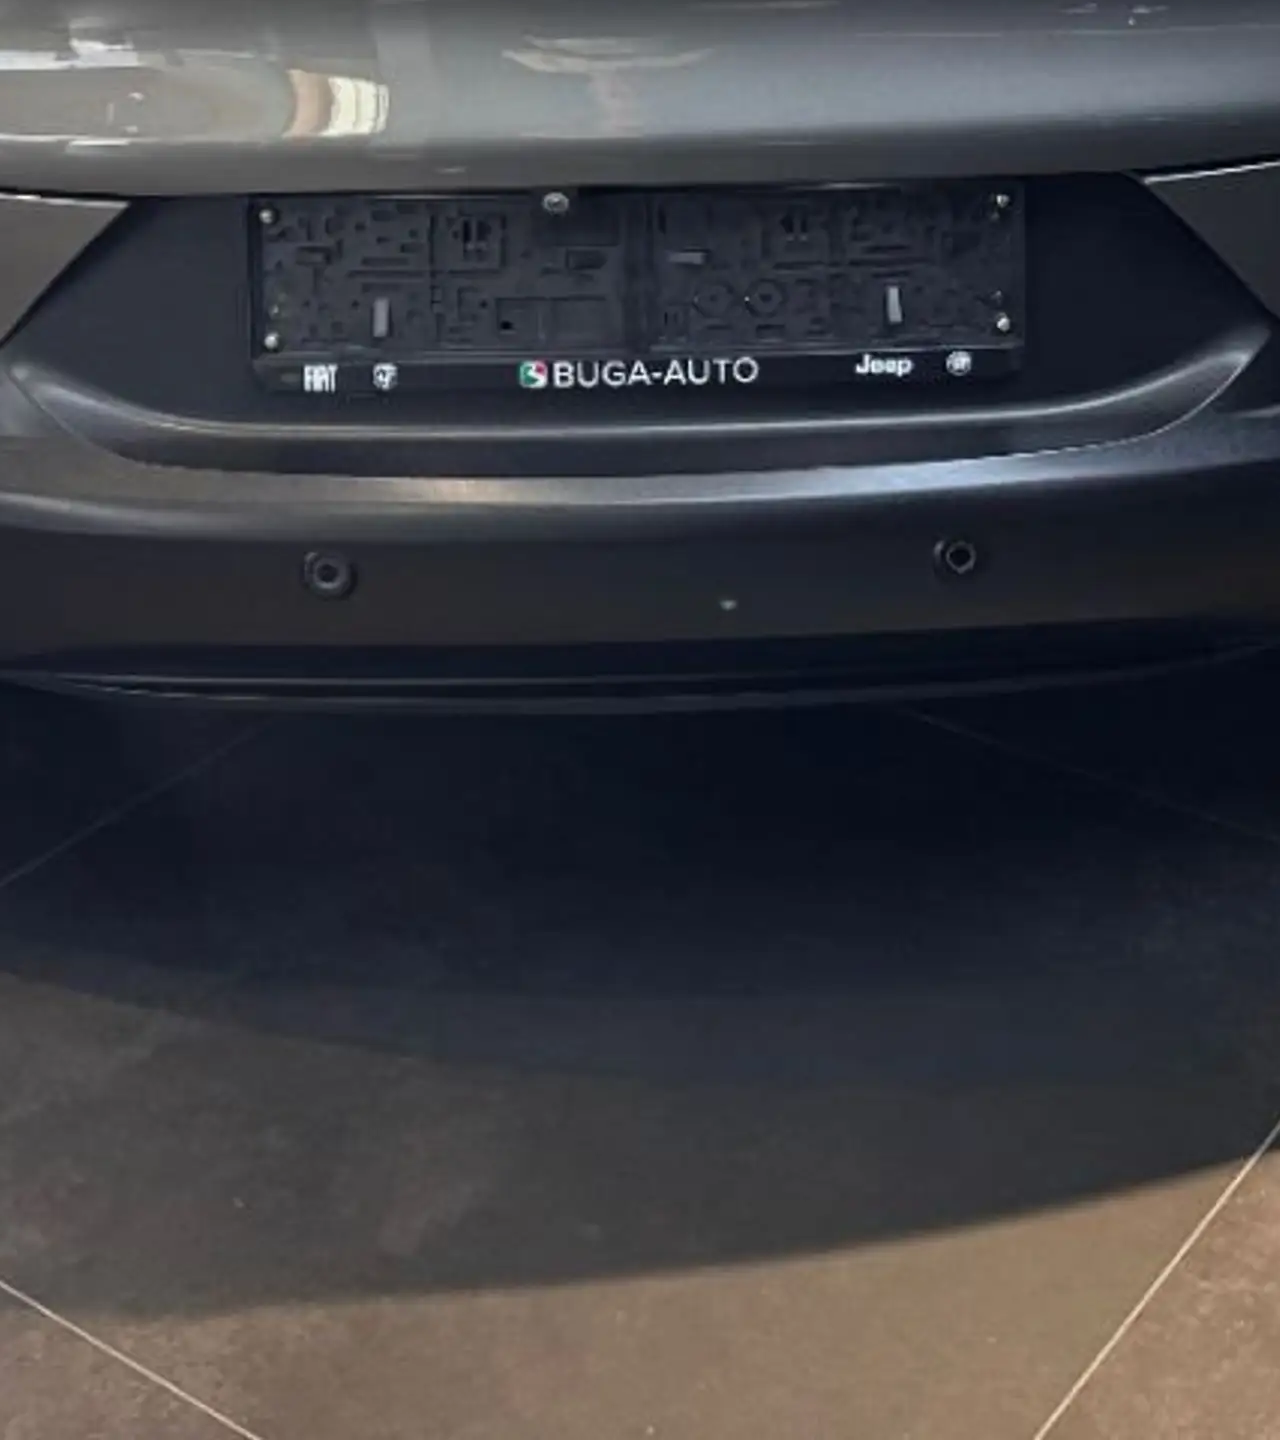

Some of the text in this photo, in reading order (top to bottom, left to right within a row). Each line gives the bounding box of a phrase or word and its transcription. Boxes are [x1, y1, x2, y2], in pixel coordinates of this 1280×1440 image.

[303, 363, 338, 393] FIAT
[553, 356, 760, 388] BUGA-AUTO
[855, 353, 914, 377] Jeep
